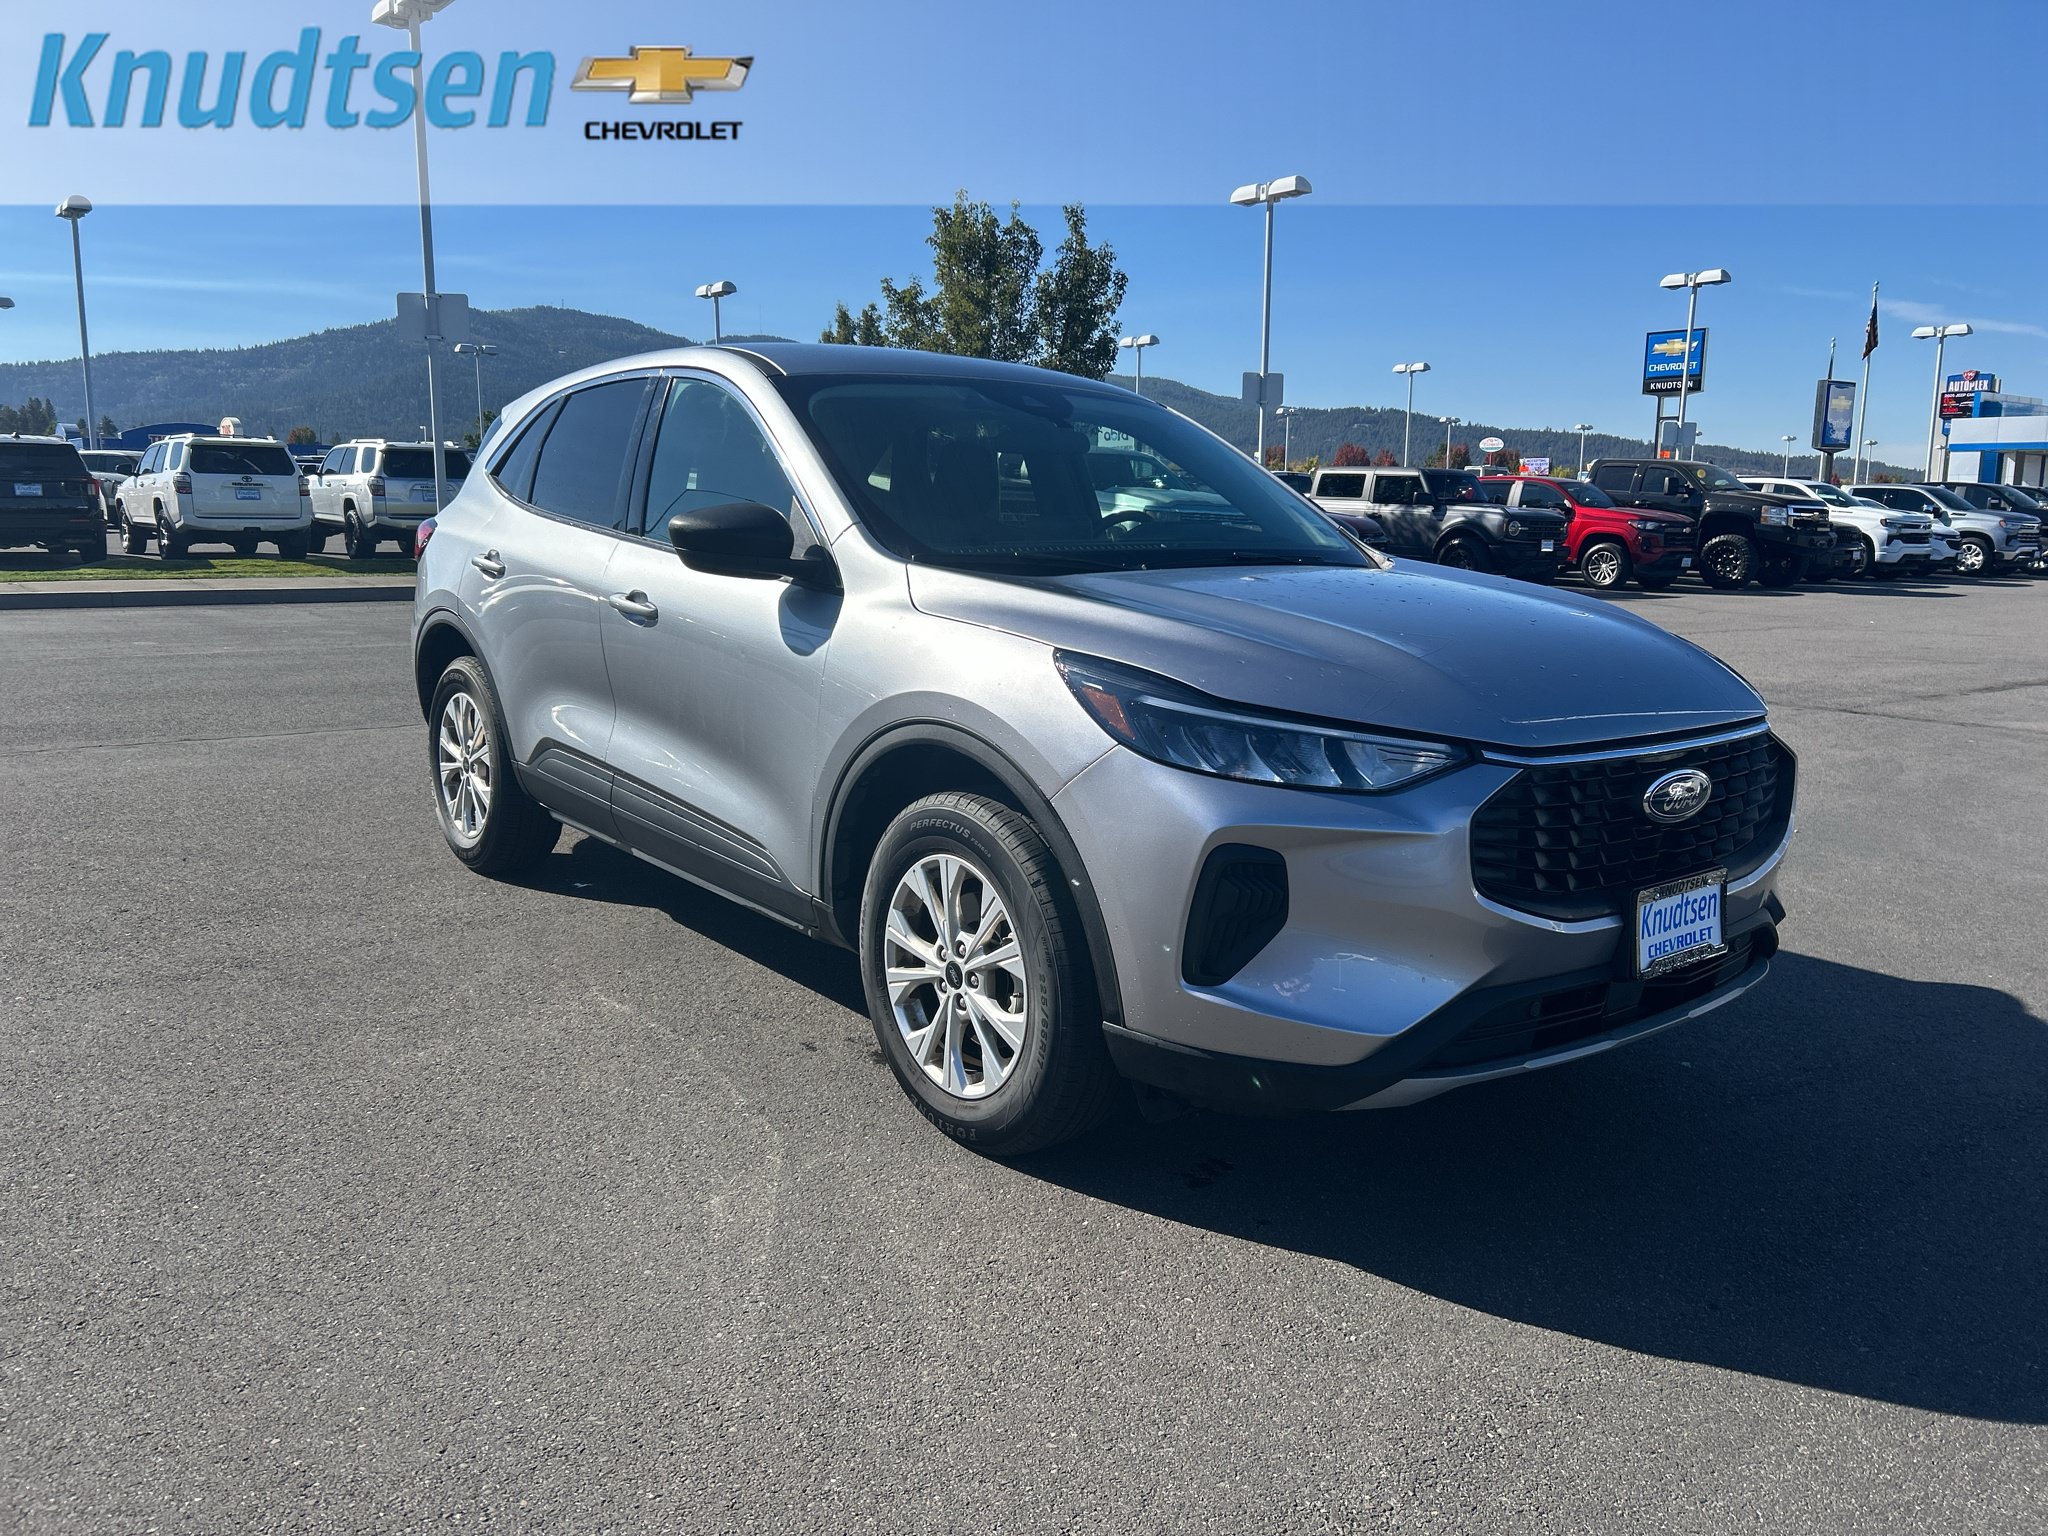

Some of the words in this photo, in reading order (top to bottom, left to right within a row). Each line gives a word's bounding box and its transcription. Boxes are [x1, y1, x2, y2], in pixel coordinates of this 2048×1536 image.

[1650, 381, 1693, 390] KNUDTSN
[1948, 380, 1989, 391] AUTOPLEX
[909, 818, 971, 838] PERFECTUS
[1641, 893, 1717, 940] Knudtsen
[1648, 926, 1713, 958] CHEVROLET
